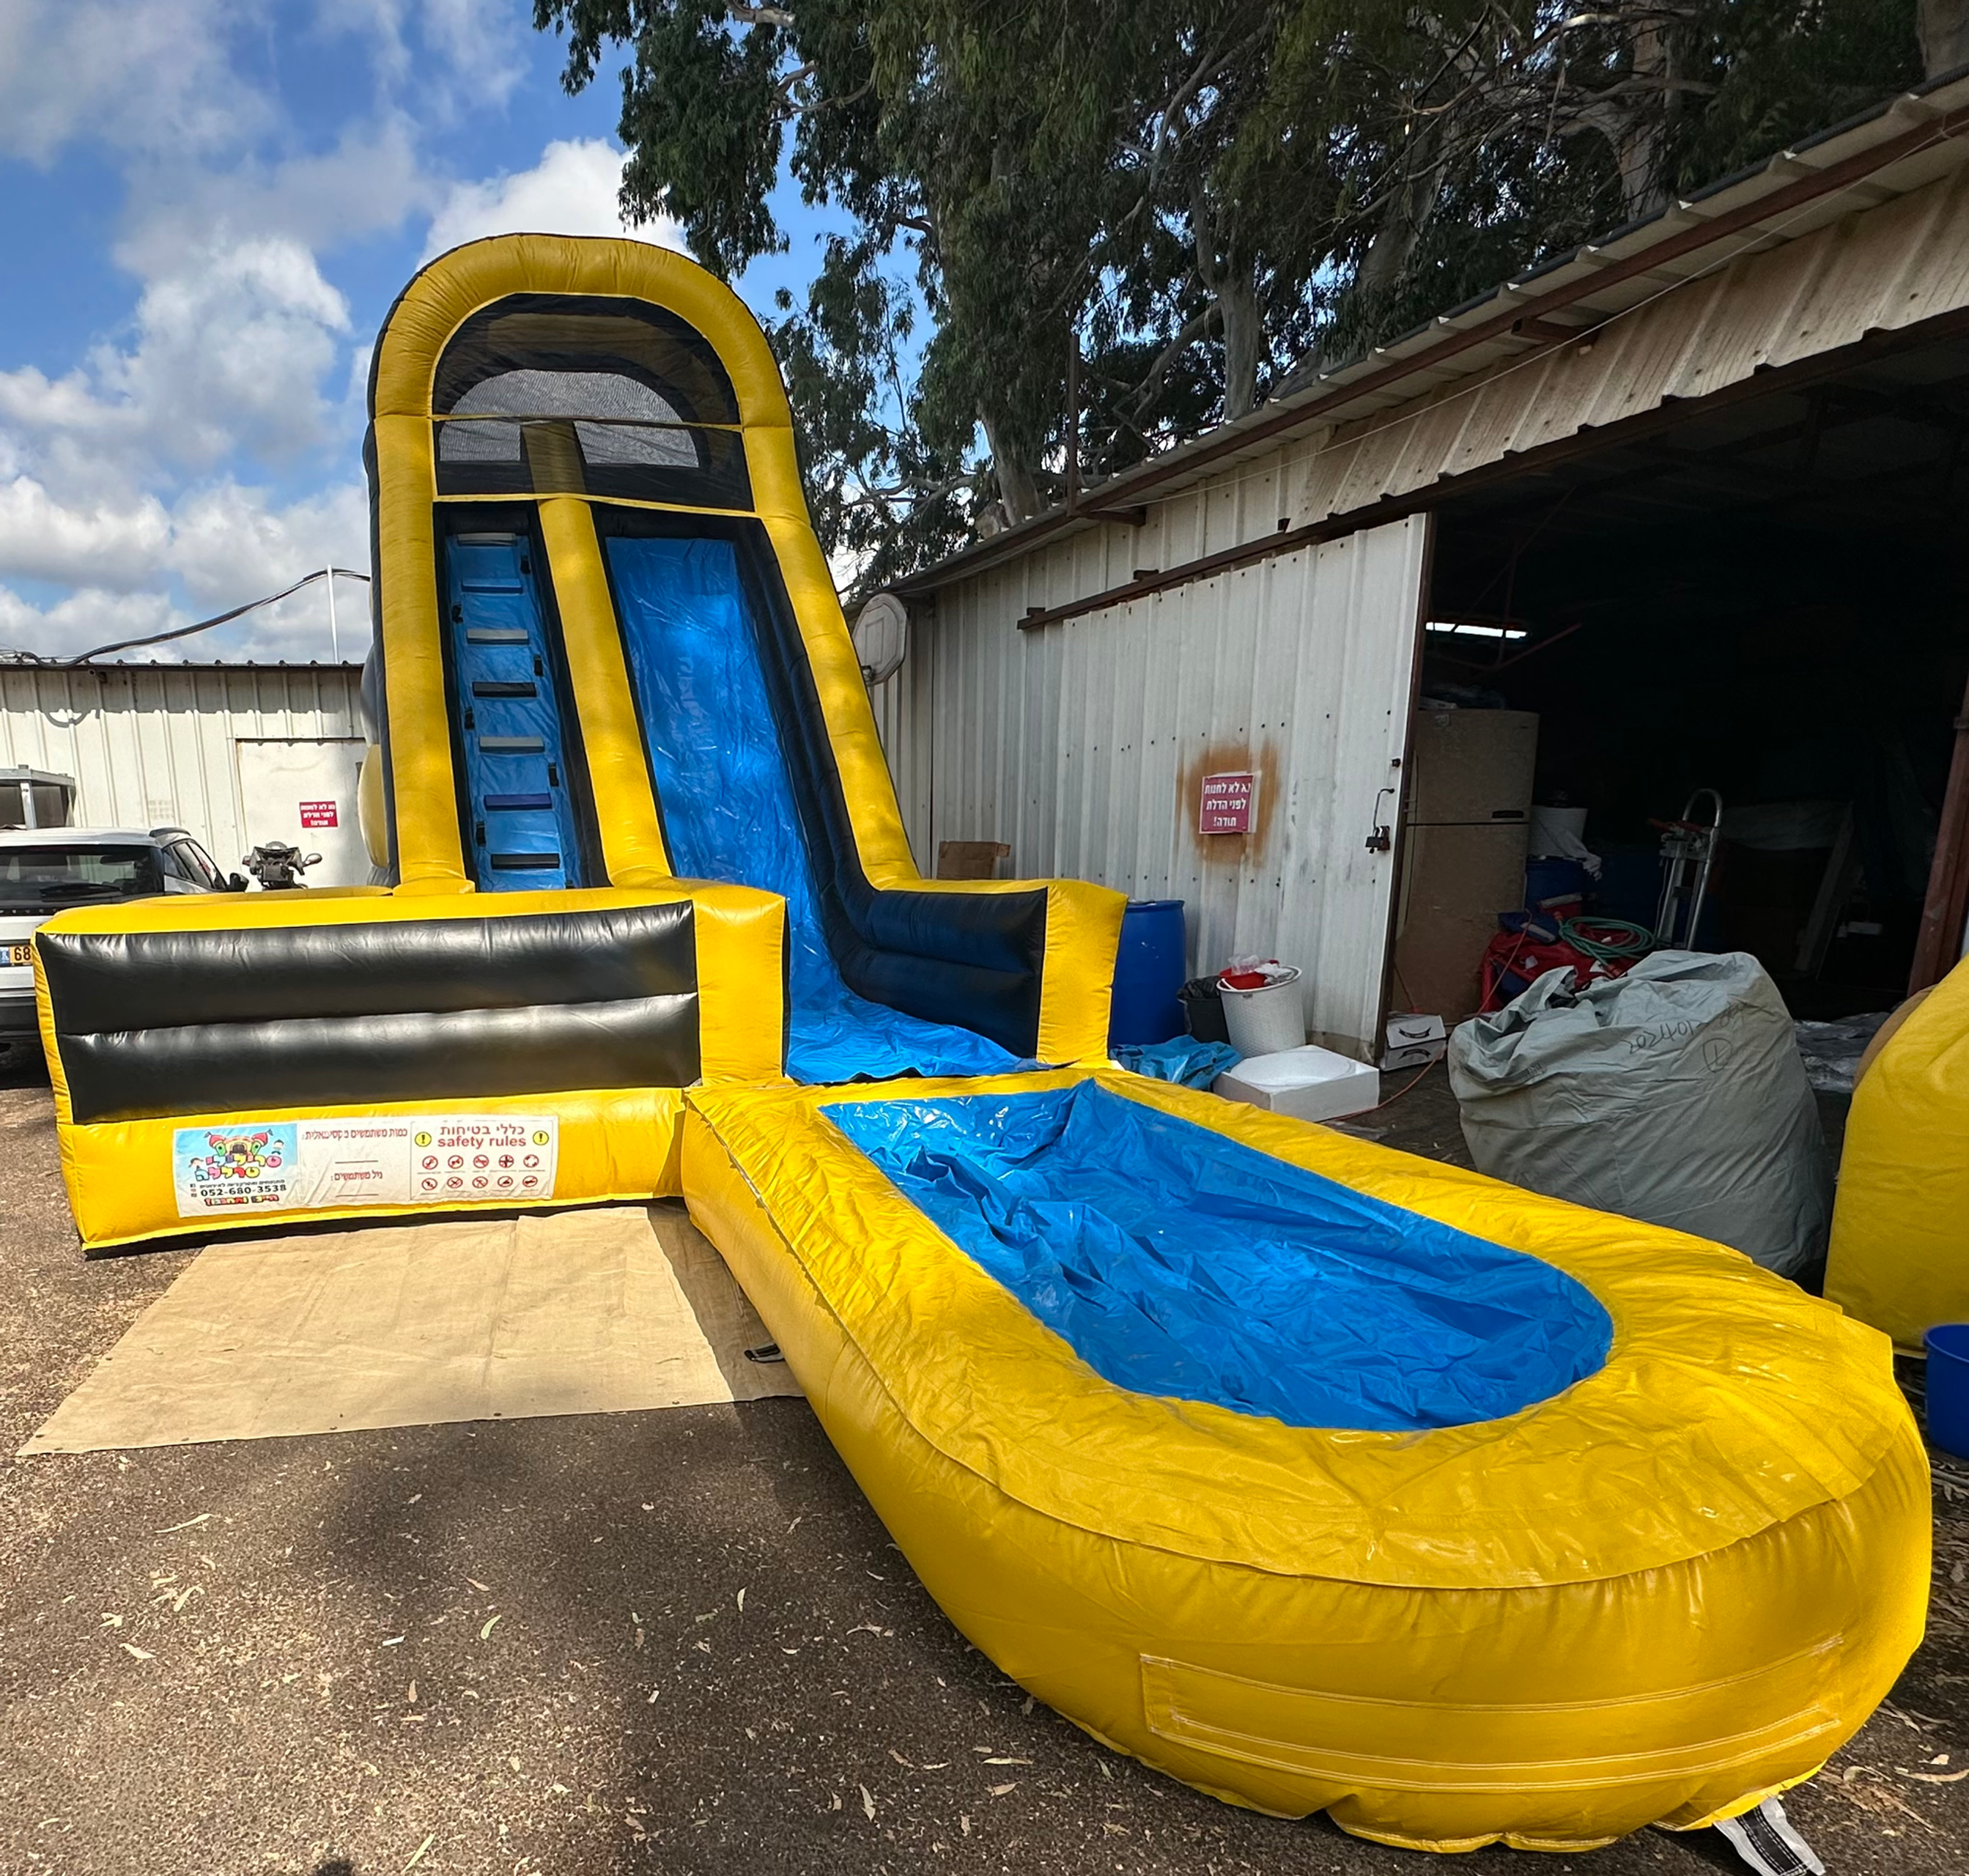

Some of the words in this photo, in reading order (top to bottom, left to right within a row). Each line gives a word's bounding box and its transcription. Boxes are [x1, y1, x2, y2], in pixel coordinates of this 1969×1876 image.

[1205, 783, 1227, 794] לחנות
[1228, 781, 1240, 793] לא
[1206, 799, 1227, 810] הדלת
[1230, 798, 1246, 810] לפני
[1213, 816, 1237, 827] תודה!
[350, 1129, 388, 1139] משתמשים
[388, 1128, 407, 1137] כמות
[440, 1126, 490, 1135] בטיחות
[496, 1123, 525, 1134] כללי
[437, 1136, 484, 1149] safety
[489, 1136, 527, 1147] rules
[372, 1170, 383, 1179] גיל
[201, 1184, 287, 1197] 052-680-3538
